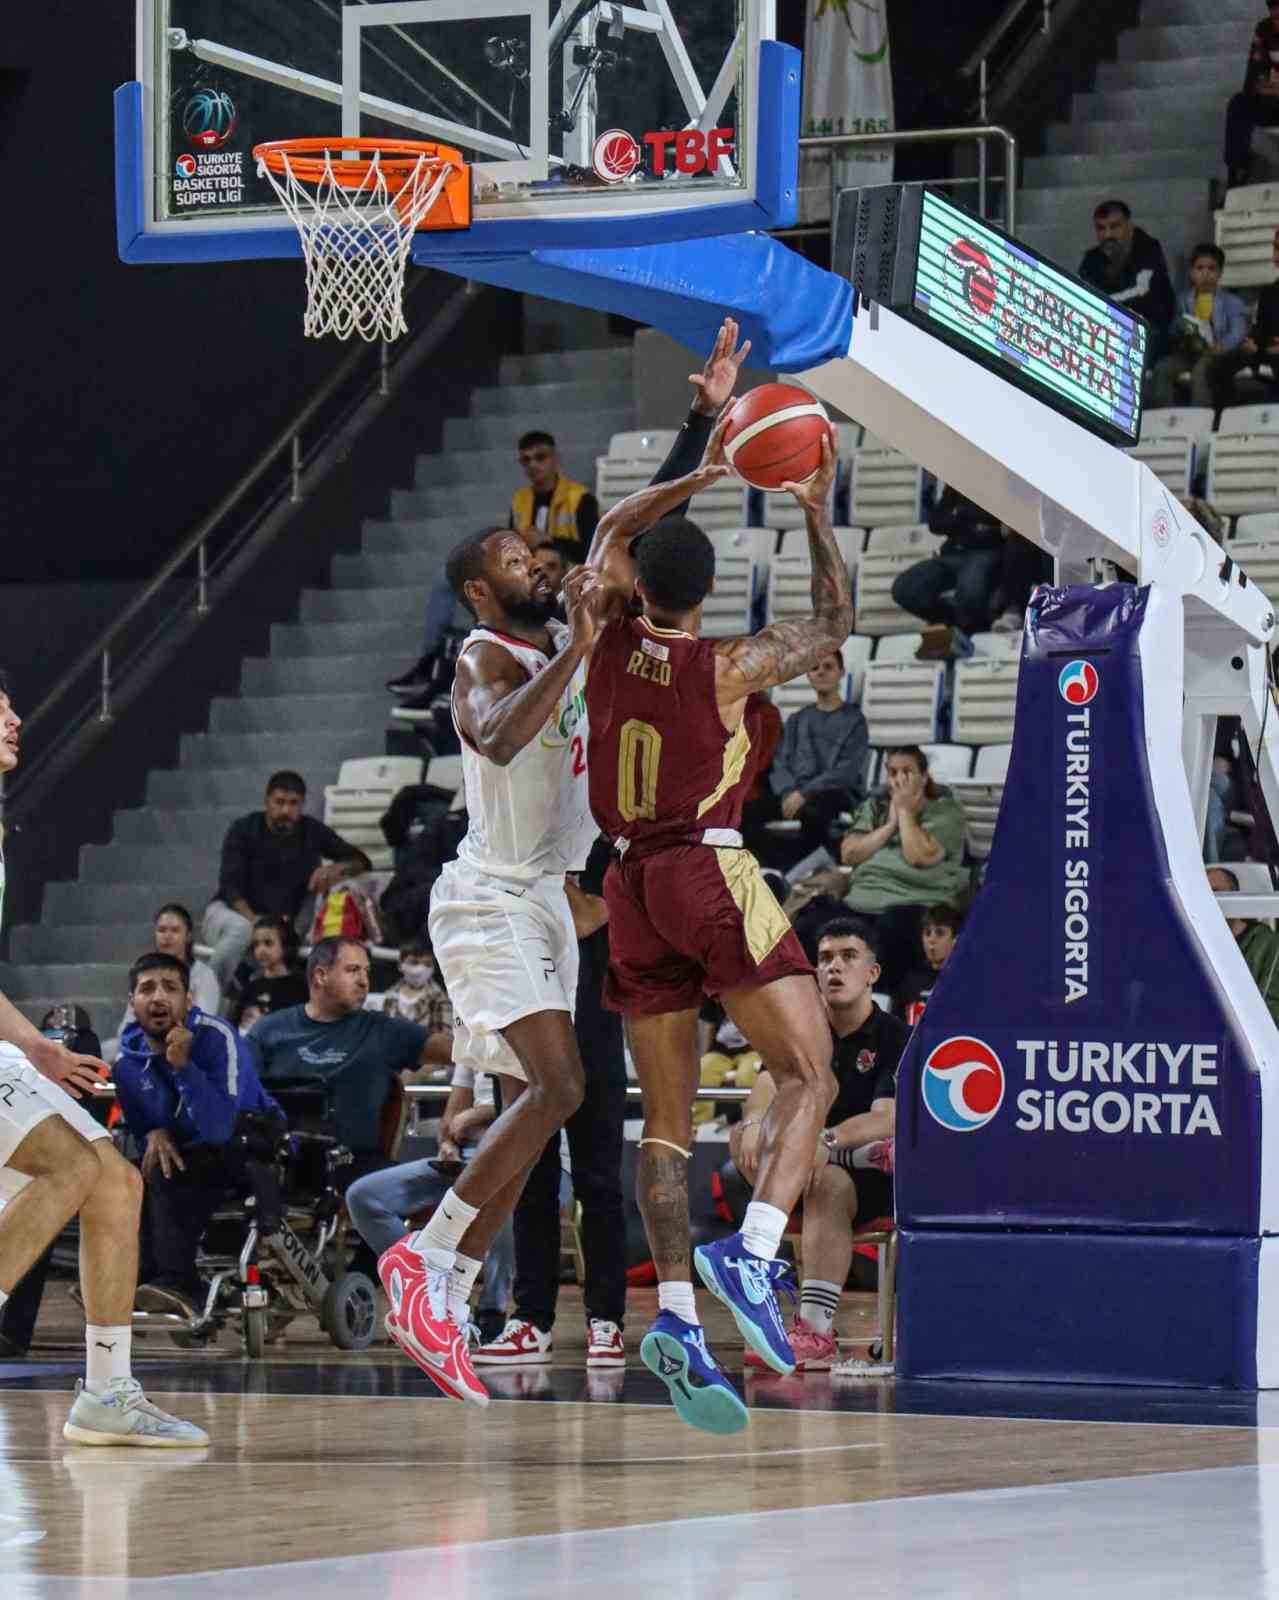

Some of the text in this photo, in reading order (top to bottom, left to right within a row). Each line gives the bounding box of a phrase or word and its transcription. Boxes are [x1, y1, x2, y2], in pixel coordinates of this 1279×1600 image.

[642, 128, 734, 176] TBF
[173, 176, 246, 191] BASKETBOL
[176, 191, 217, 206] SÜPER
[617, 718, 662, 822] 0
